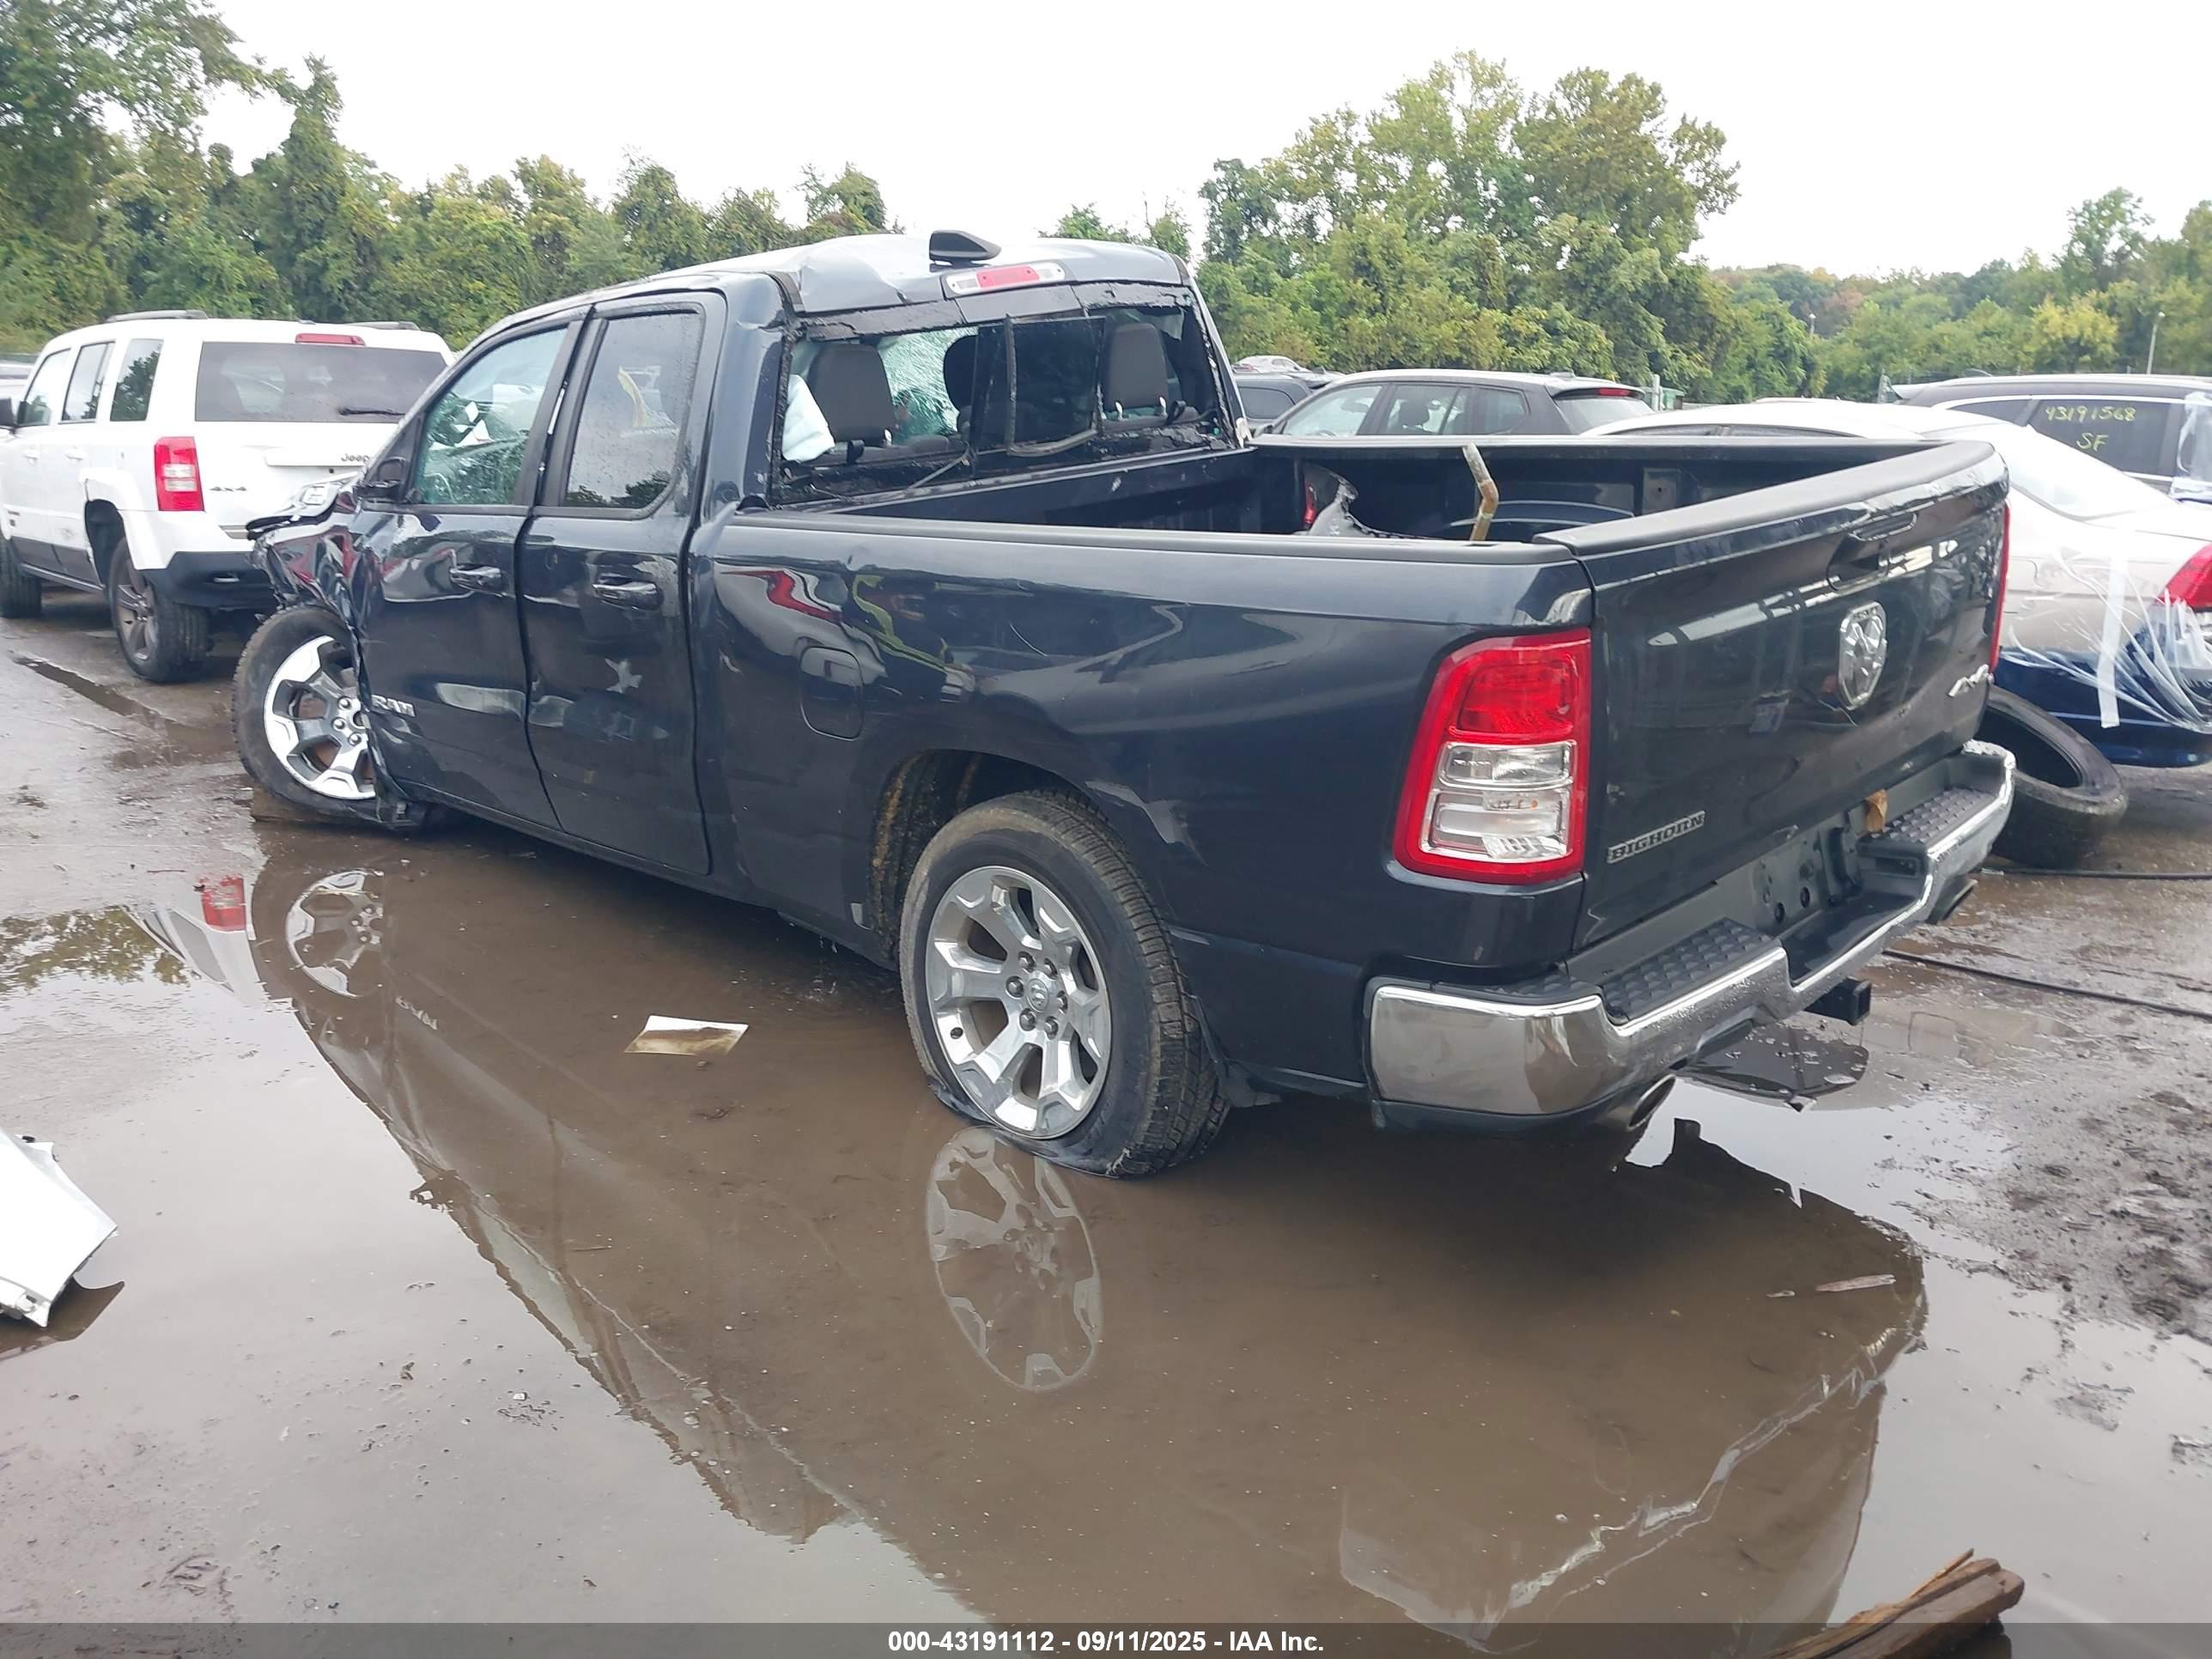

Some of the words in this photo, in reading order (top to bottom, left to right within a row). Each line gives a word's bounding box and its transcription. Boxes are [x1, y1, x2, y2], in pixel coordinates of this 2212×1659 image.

[2045, 405, 2136, 422] 43191568
[2076, 432, 2108, 451] SF
[341, 453, 371, 465] Jeep
[371, 694, 416, 718] RAM
[1607, 810, 1705, 864] BIGHORN
